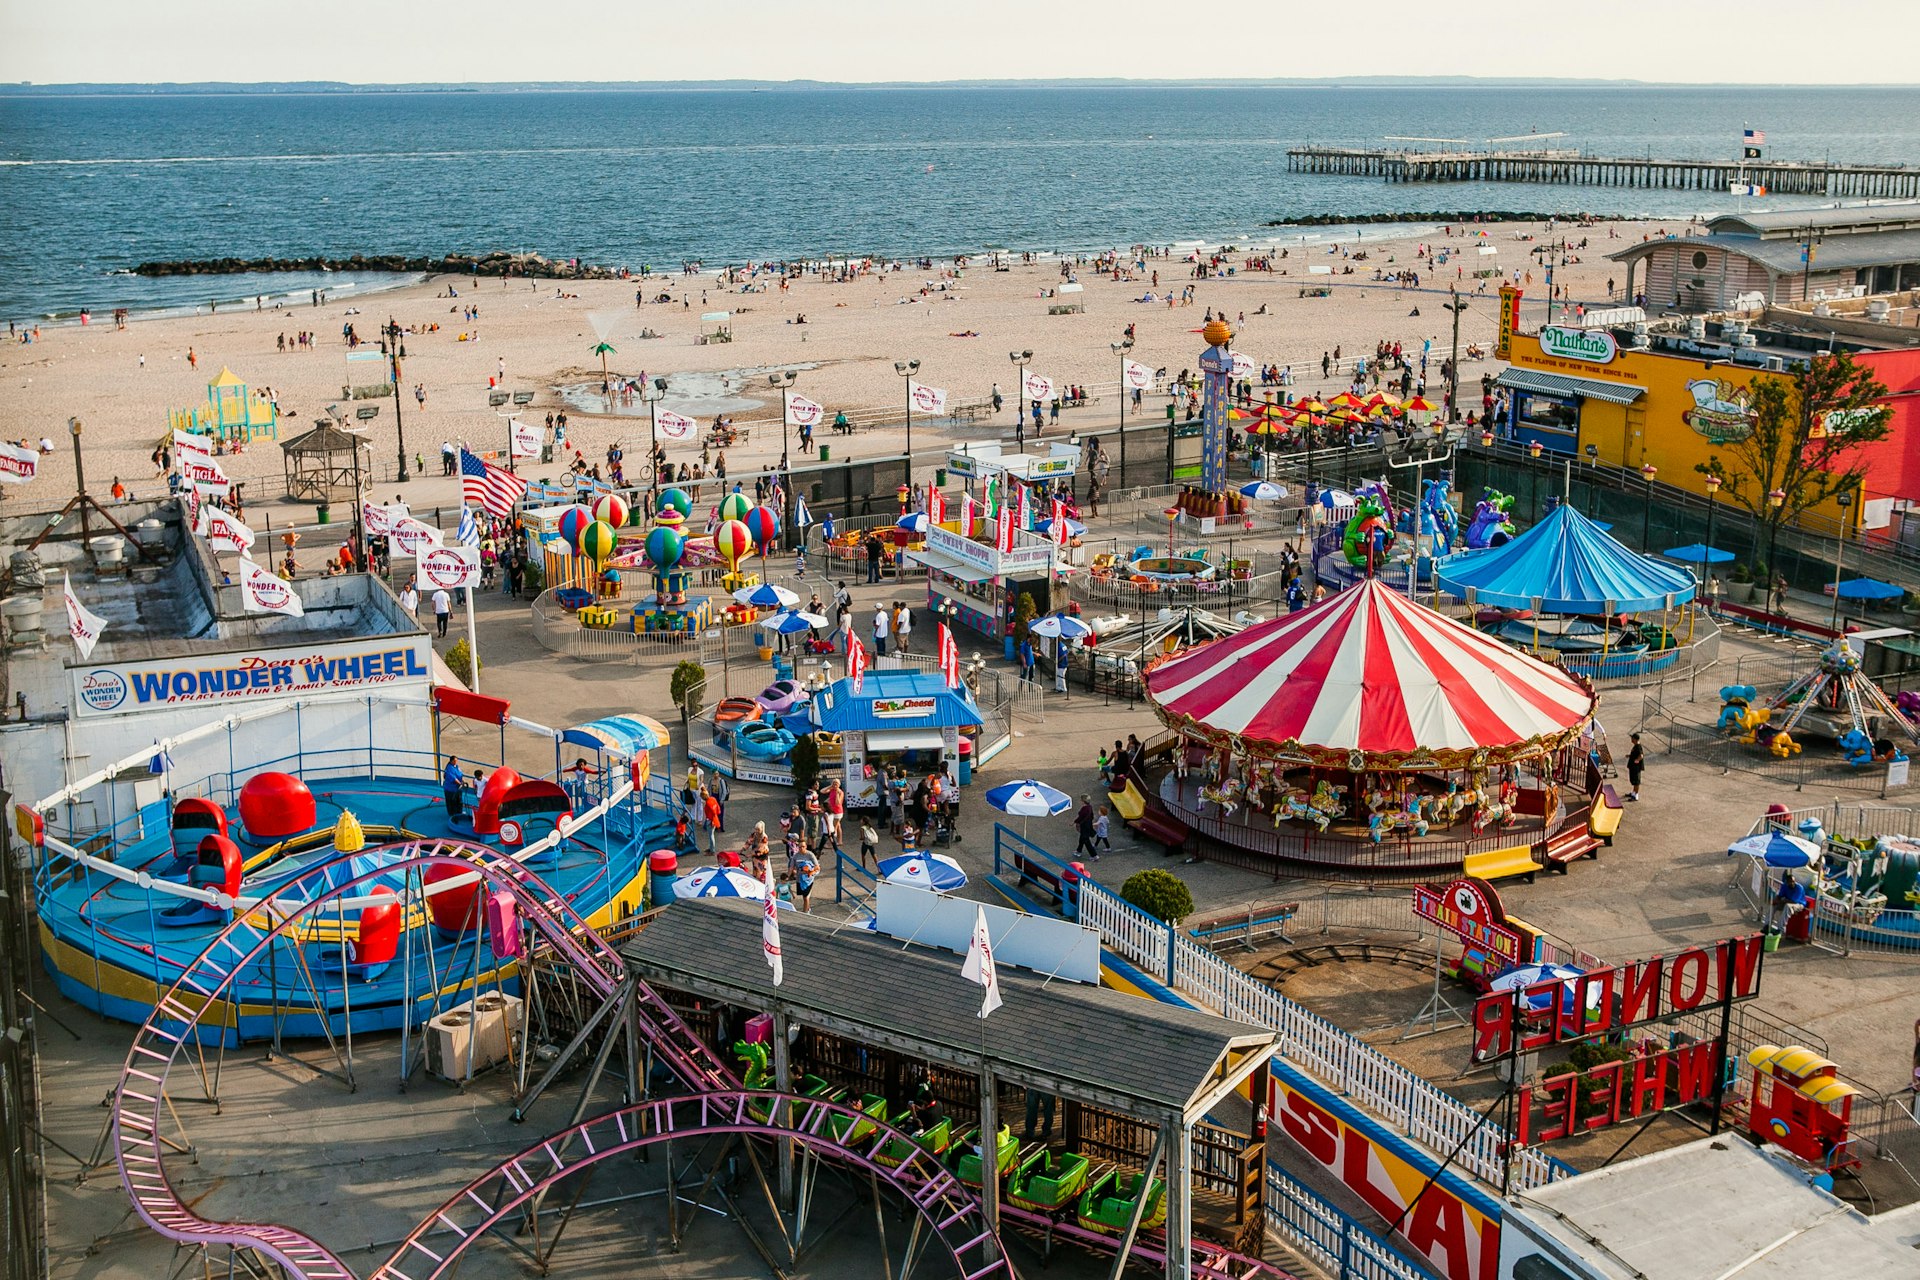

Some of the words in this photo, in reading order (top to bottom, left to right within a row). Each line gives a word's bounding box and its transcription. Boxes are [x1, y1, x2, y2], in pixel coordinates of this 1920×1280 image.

[1502, 294, 1511, 350] NATHANS
[1544, 328, 1609, 354] Nathan's
[421, 562, 451, 572] WONDER
[454, 563, 477, 573] WHEEL
[239, 655, 324, 671] Deno's
[83, 675, 119, 689] Deno's
[128, 666, 294, 704] WONDER
[303, 647, 427, 684] WHEEL
[86, 687, 121, 696] WONDER
[167, 695, 176, 704] A
[180, 692, 216, 701] PLACE
[220, 689, 242, 698] FOR
[246, 687, 270, 696] FUN
[273, 685, 283, 693] &
[287, 680, 327, 691] FAMILY
[332, 677, 365, 687] SINCE
[368, 674, 397, 683] 1920
[91, 694, 118, 702] WHEEL
[874, 701, 889, 711] Say
[769, 775, 779, 783] THE
[1832, 846, 1848, 856] EXIT
[1824, 900, 1843, 912] EXIT
[1420, 895, 1459, 929] TRAIN
[1461, 916, 1513, 956] STATION
